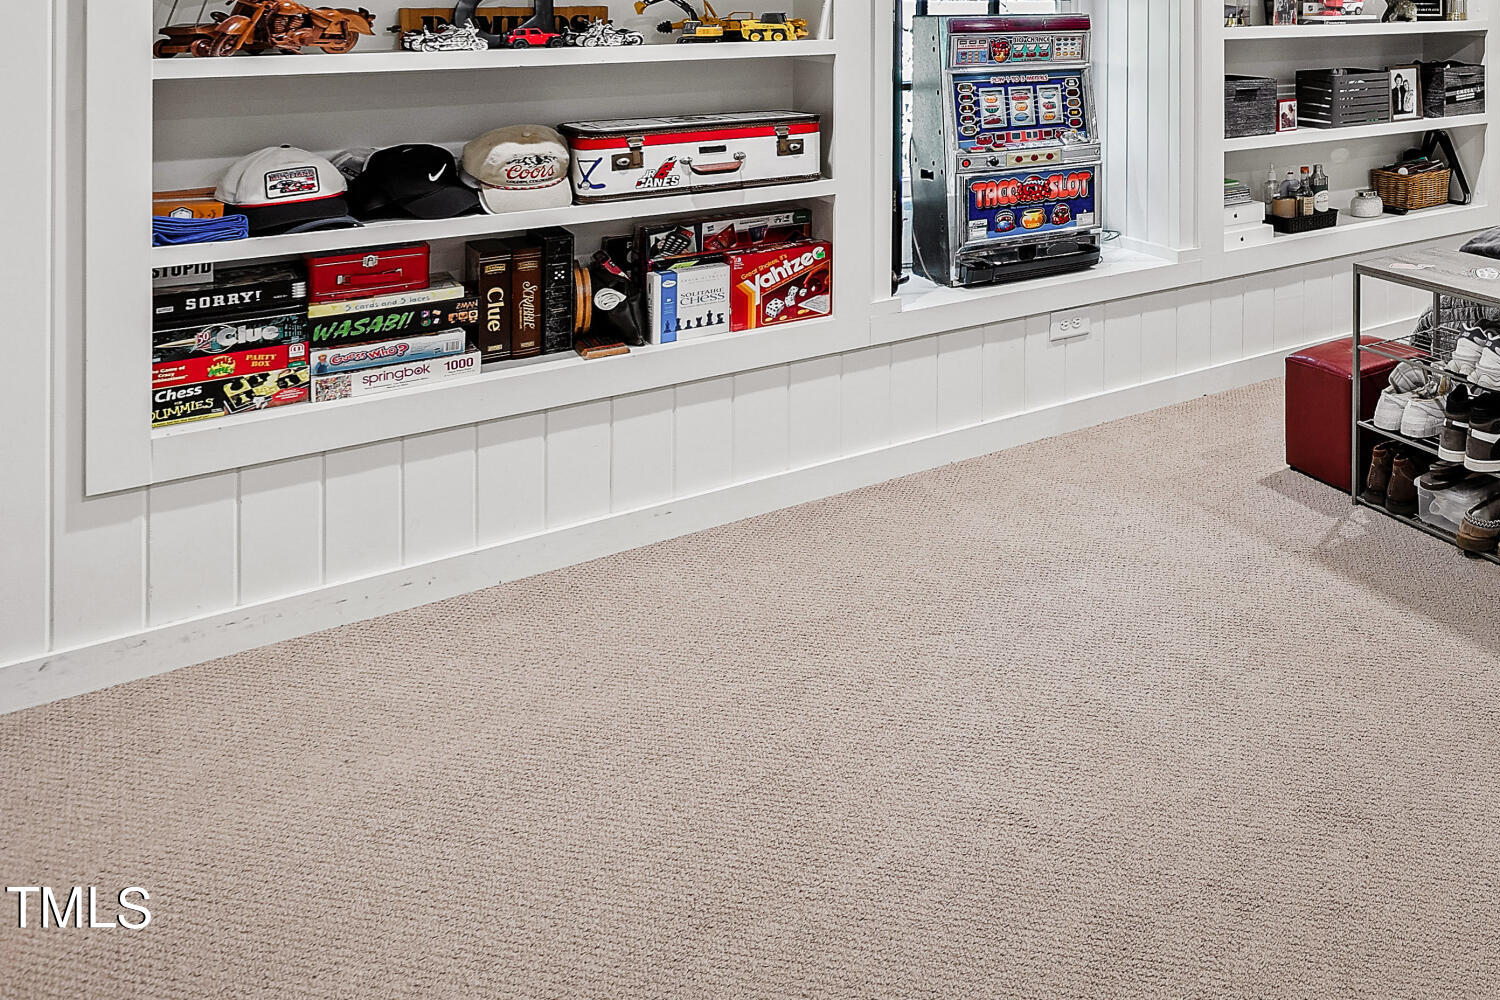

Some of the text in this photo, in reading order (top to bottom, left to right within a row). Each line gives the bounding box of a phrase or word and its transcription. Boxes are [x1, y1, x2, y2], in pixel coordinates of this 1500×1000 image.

[506, 164, 555, 179] Coors
[643, 169, 656, 178] JR
[635, 175, 680, 189] CANES
[971, 171, 1092, 208] TACO SLOT
[152, 263, 212, 279] STUPID
[743, 247, 825, 305] Yahtzee
[185, 290, 262, 310] SORRY!
[680, 288, 722, 297] SOLITAIRE
[355, 302, 379, 310] cards
[409, 295, 430, 303] laces
[487, 286, 505, 332] Clue
[313, 311, 416, 342] WASABI!
[216, 325, 279, 347] Clue
[362, 357, 474, 386] springbok 1000
[154, 386, 203, 402] Chess
